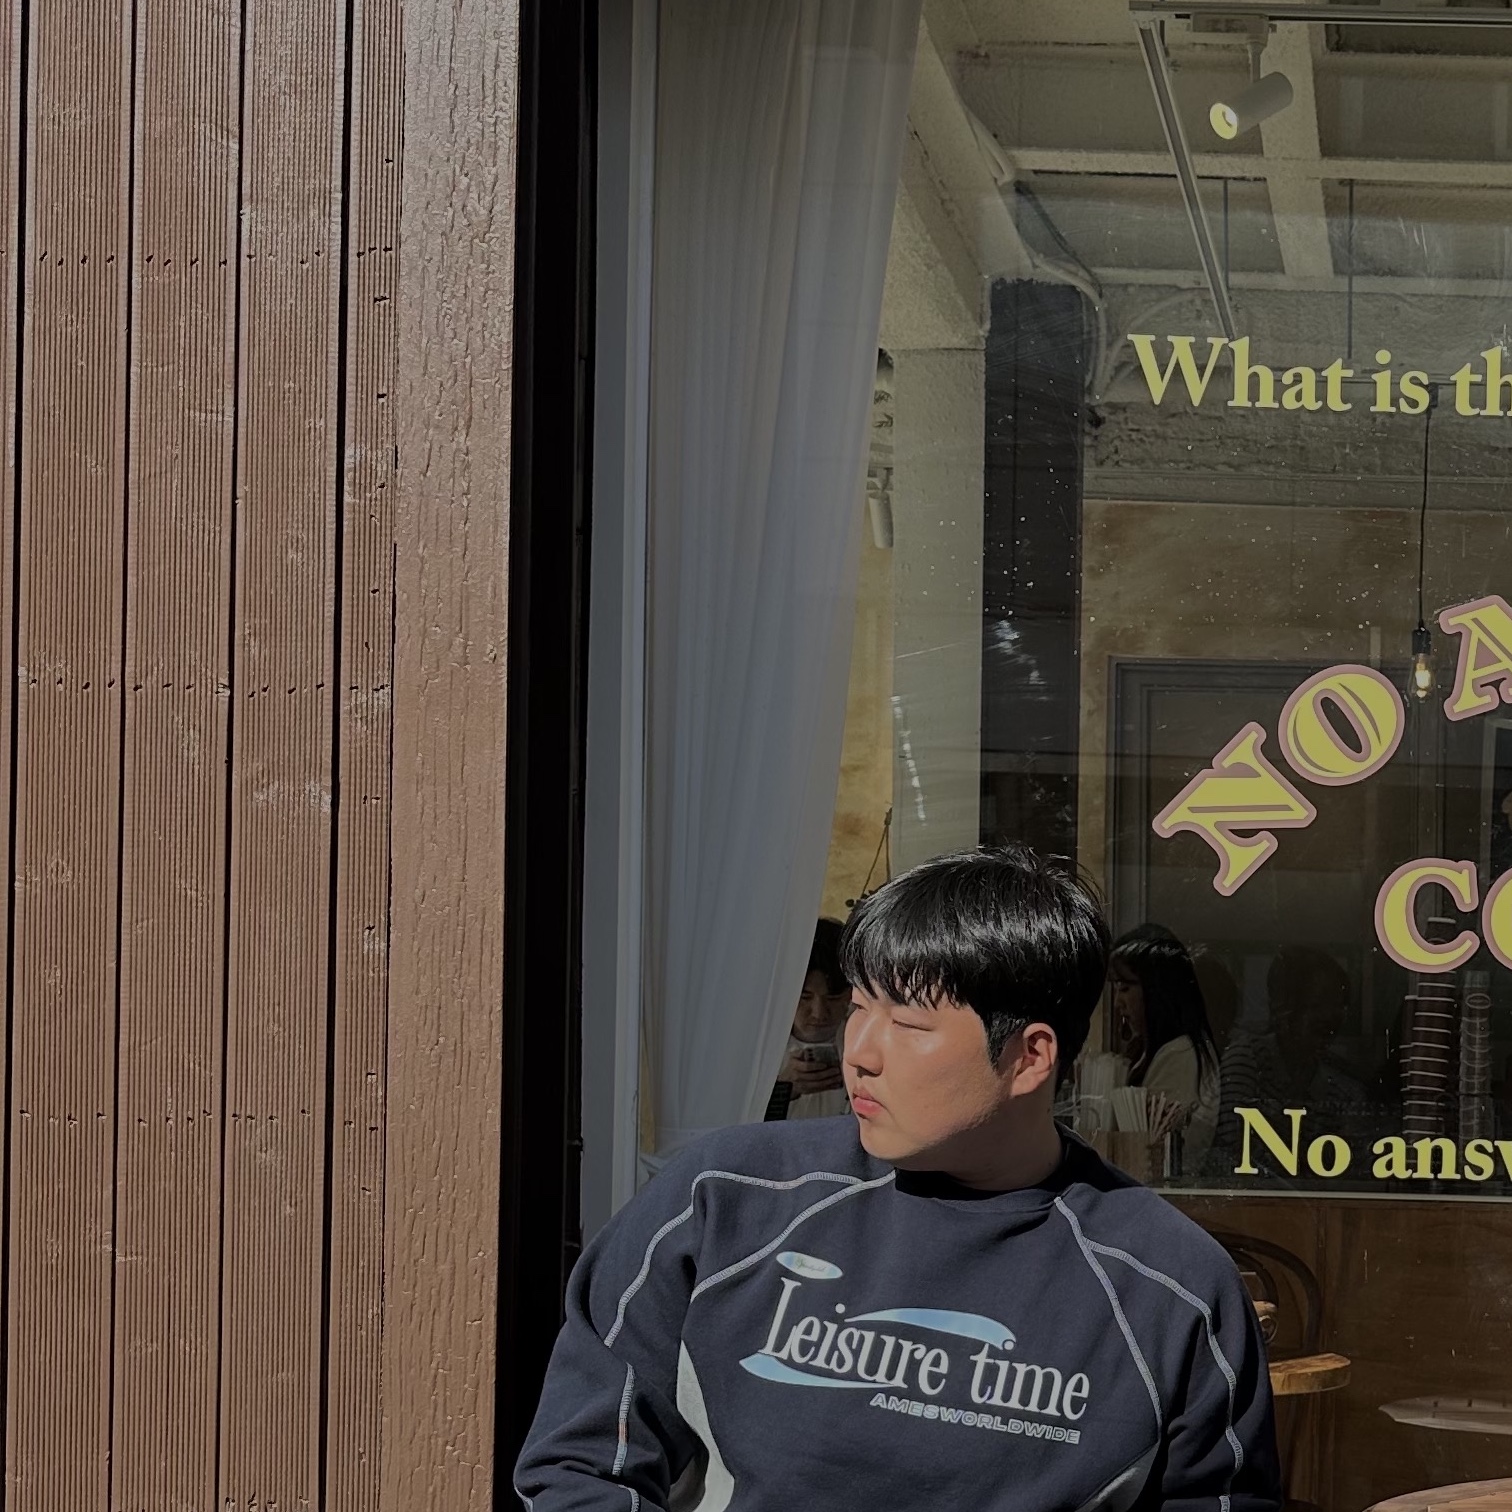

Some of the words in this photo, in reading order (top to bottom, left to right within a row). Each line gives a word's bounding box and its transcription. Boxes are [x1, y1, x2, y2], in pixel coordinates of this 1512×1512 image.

[1128, 333, 1354, 412] What
[1371, 350, 1430, 414] is
[1153, 664, 1405, 897] NO
[1233, 1107, 1352, 1178] No
[756, 1276, 949, 1395] Leisure
[969, 1339, 1091, 1421] time
[869, 1392, 1082, 1445] AMESWORLDWIDE
